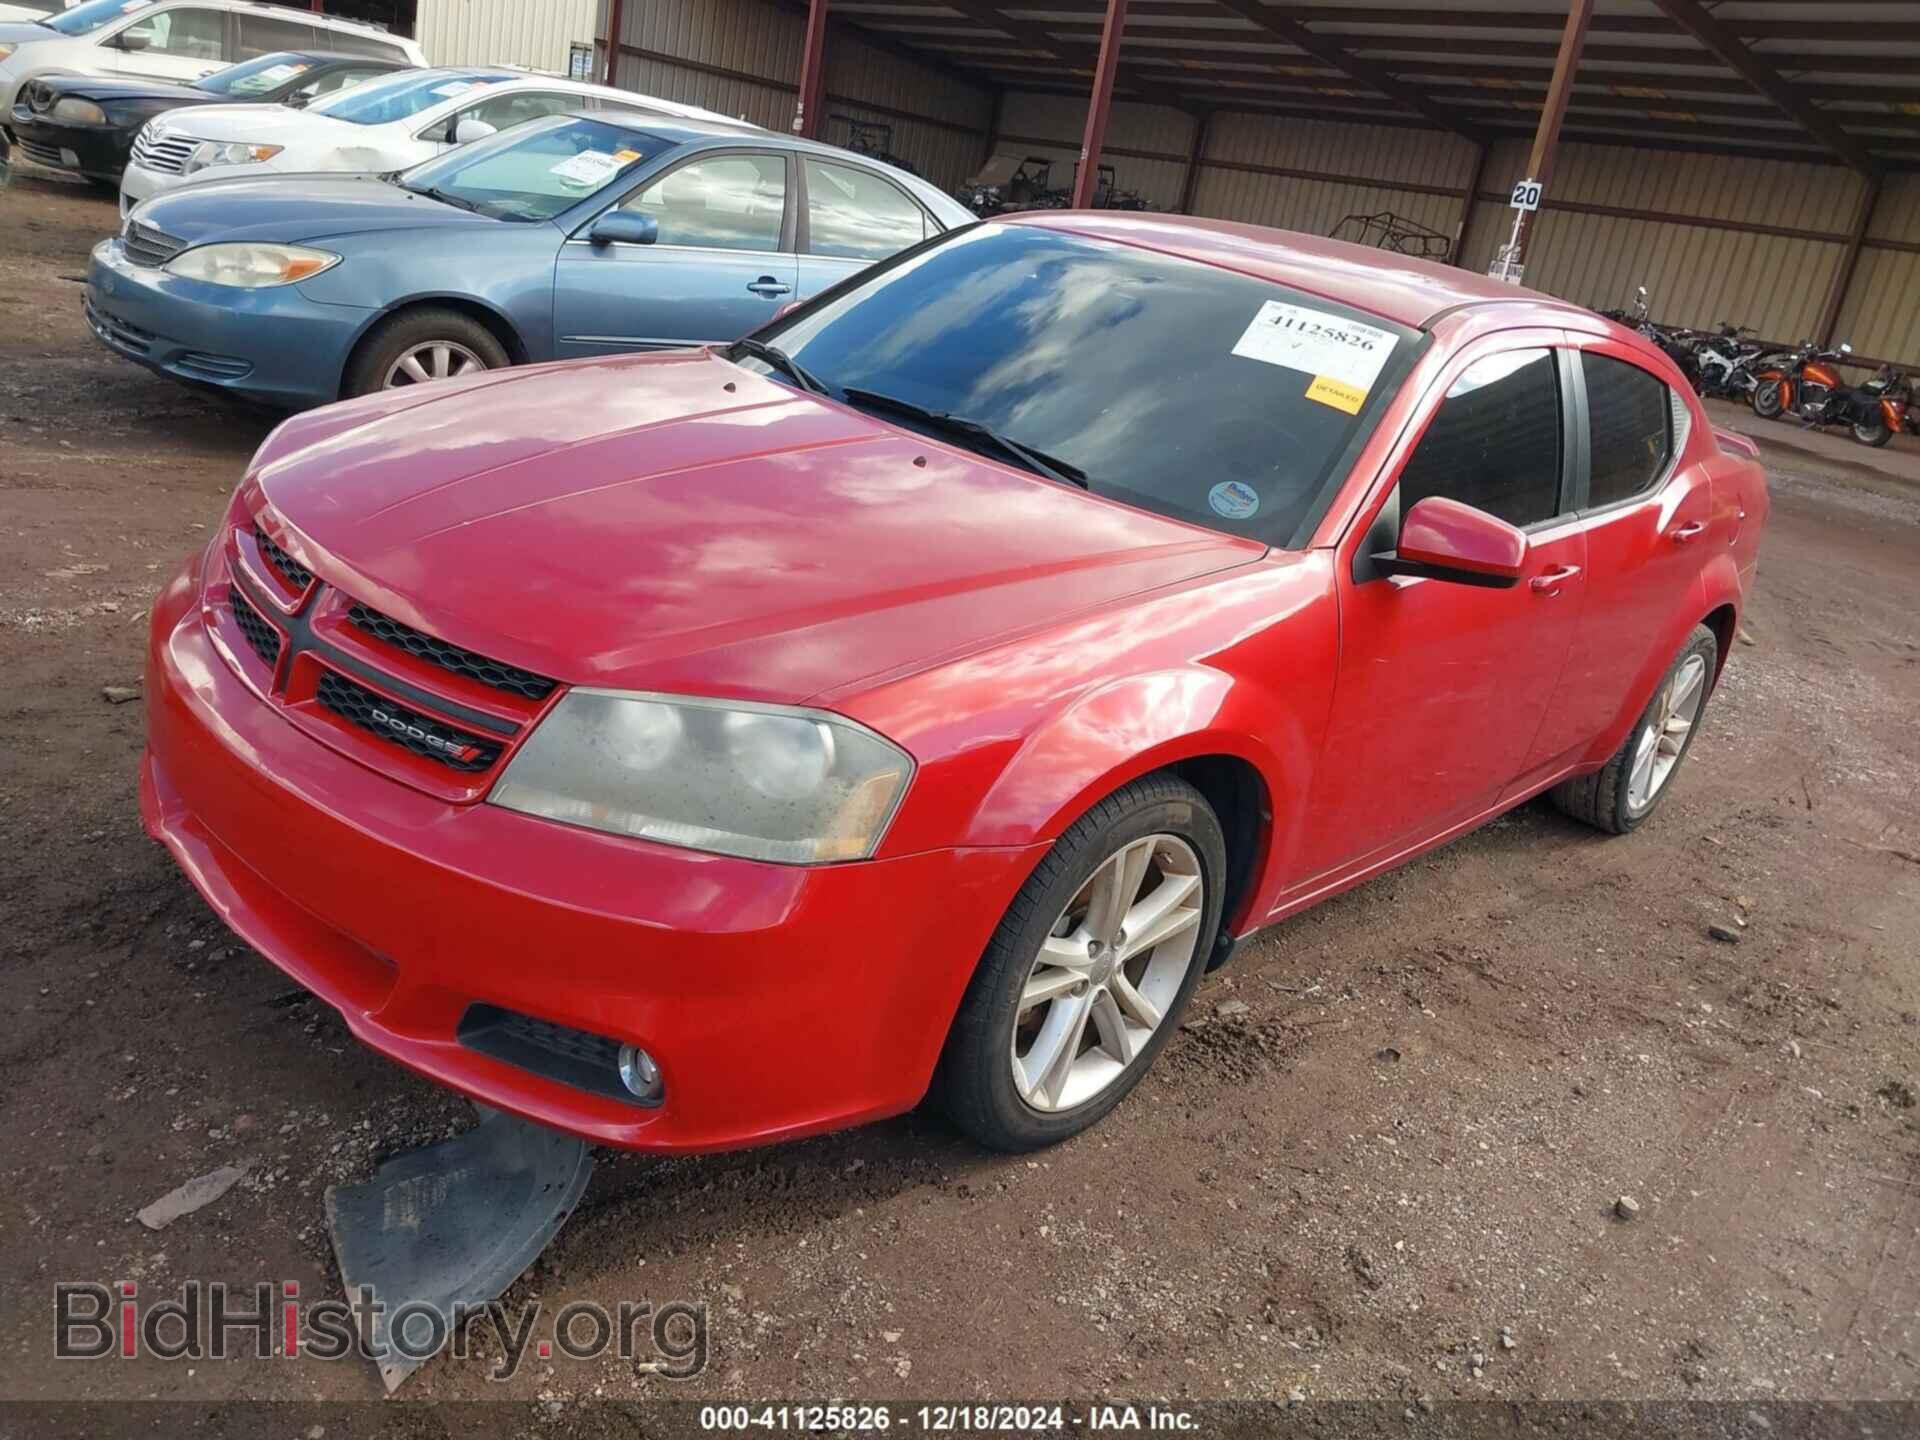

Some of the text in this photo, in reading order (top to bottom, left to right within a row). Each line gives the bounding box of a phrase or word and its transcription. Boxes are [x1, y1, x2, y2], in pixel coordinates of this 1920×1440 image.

[1513, 185, 1538, 205] 20
[1268, 315, 1374, 351] 41125826
[1316, 383, 1359, 403] DETAILED
[373, 709, 464, 755] DODGE
